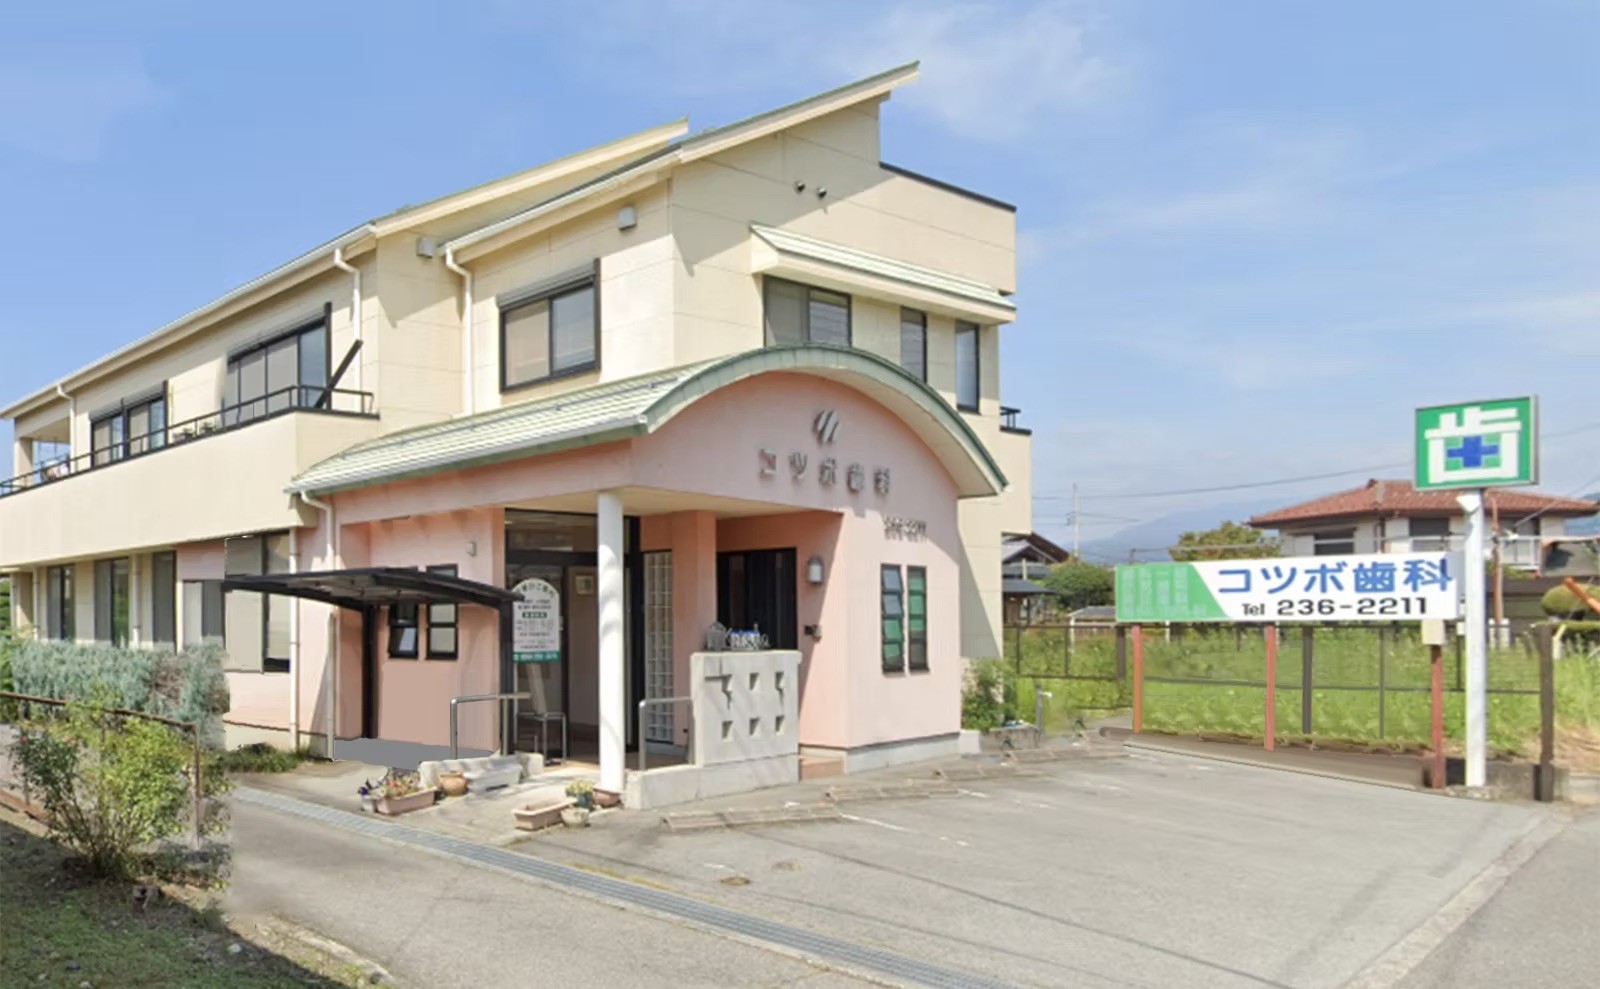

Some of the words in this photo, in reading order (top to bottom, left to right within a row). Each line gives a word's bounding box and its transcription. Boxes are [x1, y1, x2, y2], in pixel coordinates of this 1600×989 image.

[1424, 406, 1521, 484] 歯
[1218, 558, 1453, 594] コツボ歯科
[1242, 603, 1265, 616] Tel
[1277, 597, 1427, 616] 236-2211
